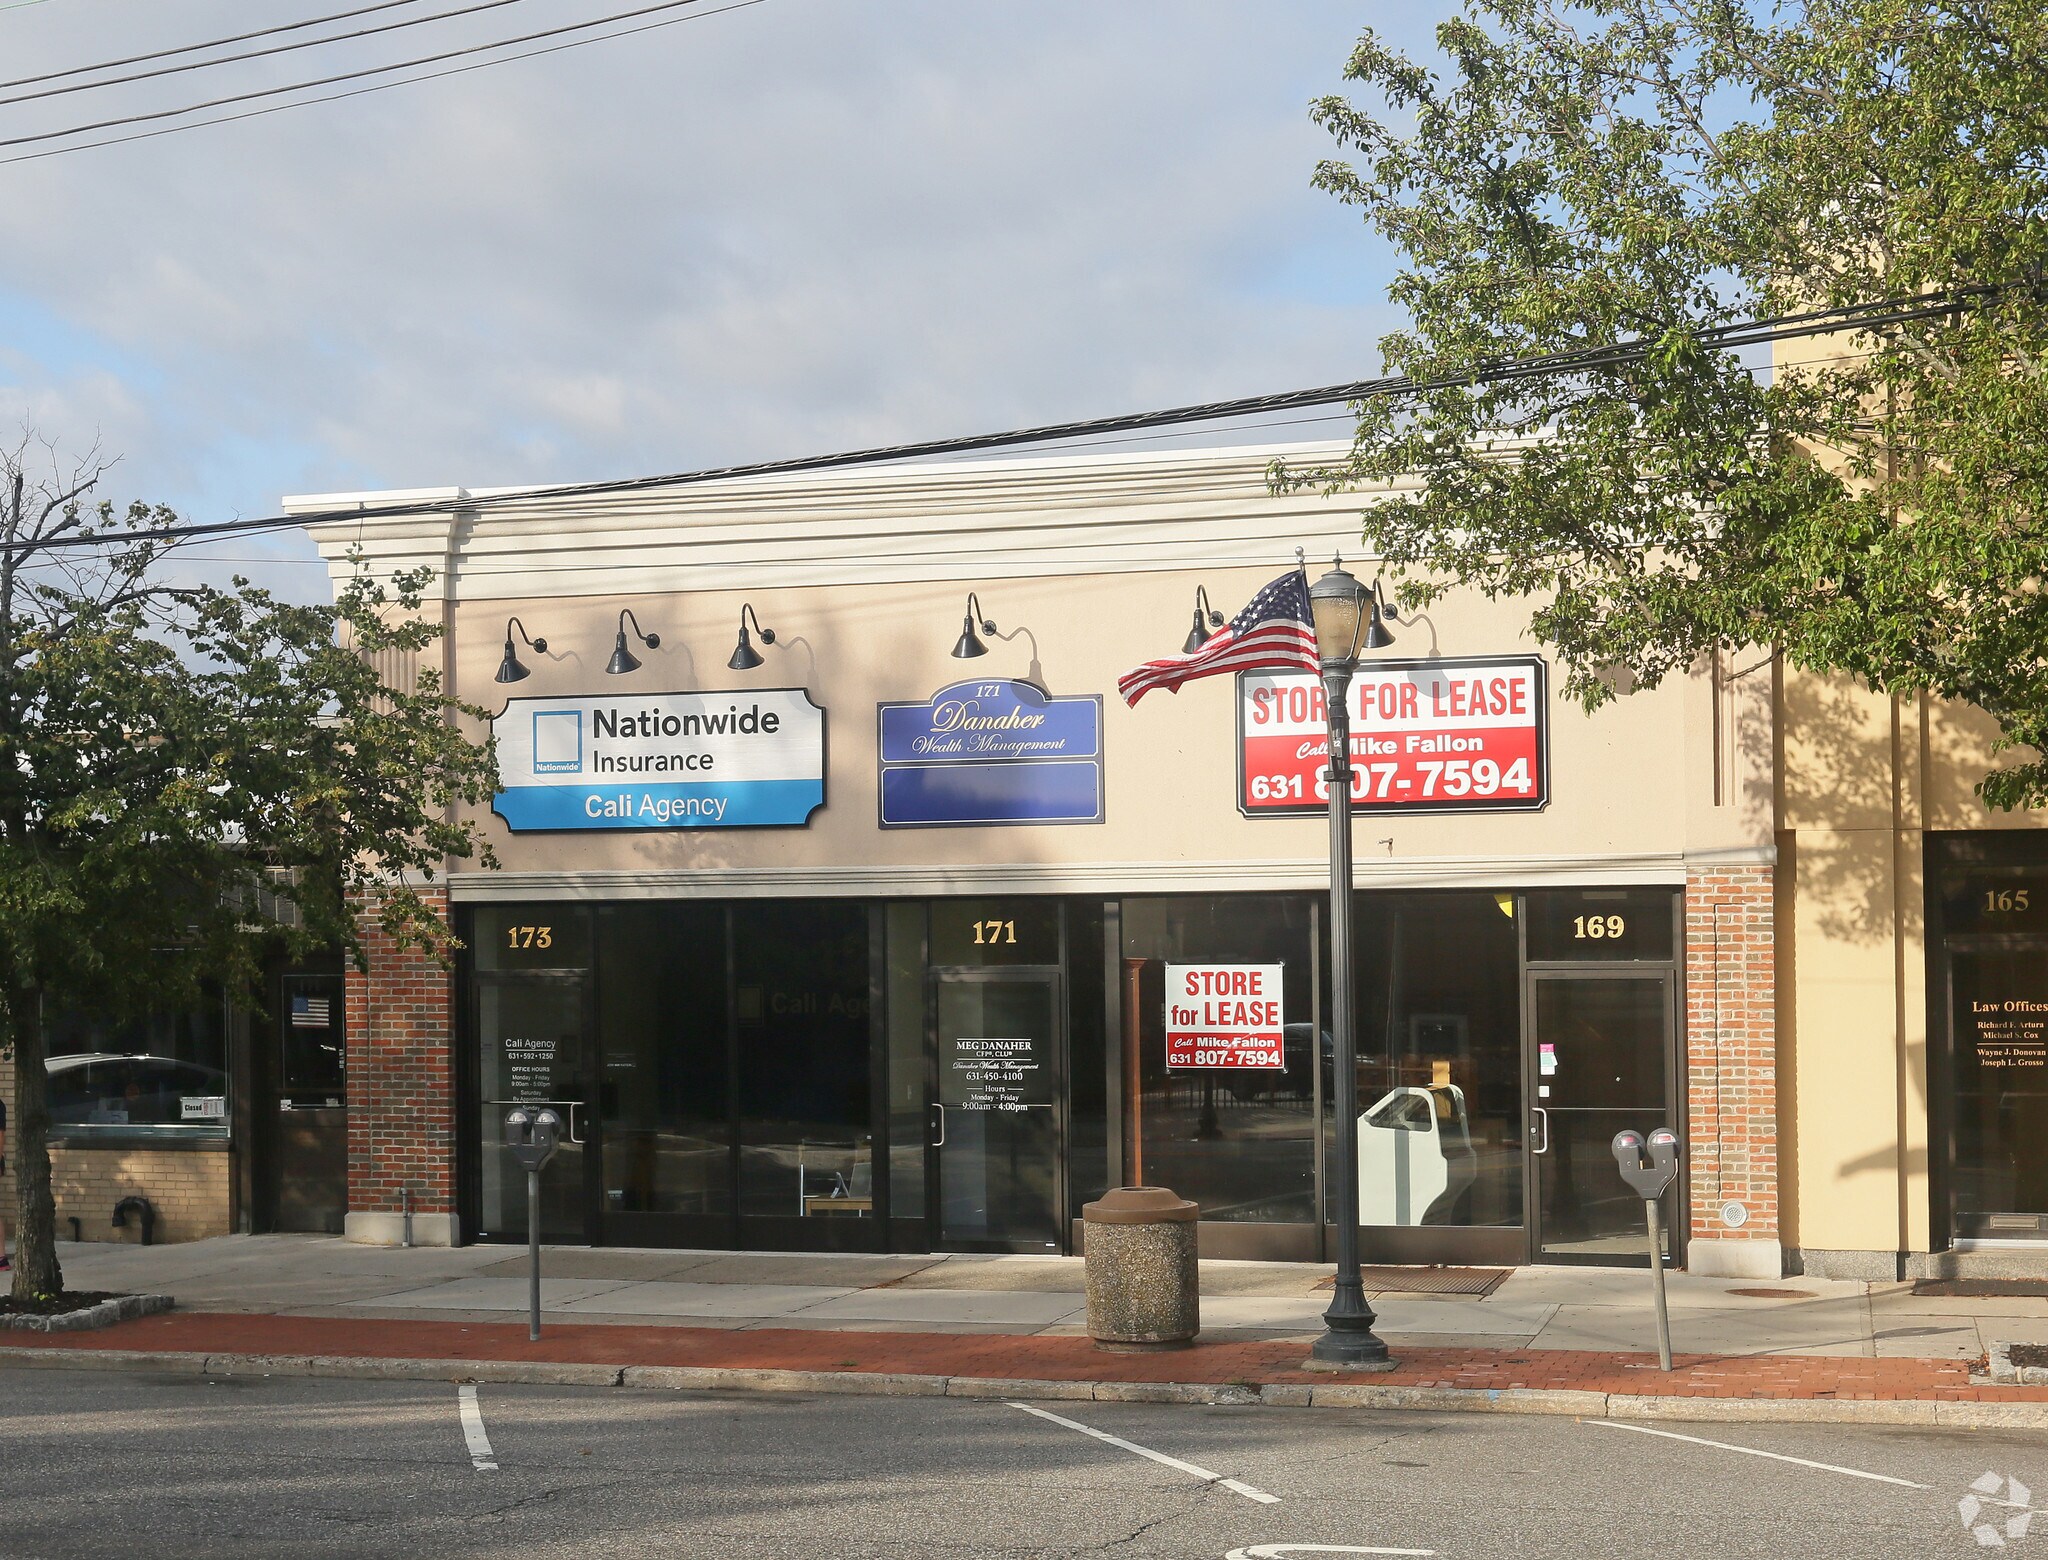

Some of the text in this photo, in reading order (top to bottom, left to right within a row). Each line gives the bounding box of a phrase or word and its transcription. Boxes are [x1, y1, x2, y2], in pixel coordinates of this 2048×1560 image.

[975, 685, 1000, 698] 171
[1253, 677, 1526, 725] STOR FOR LEASE
[593, 705, 780, 738] Nationwide
[930, 700, 1045, 733] Danaher
[911, 733, 1066, 757] Wealth Management
[1296, 741, 1329, 759] Call
[1405, 734, 1483, 754] Fallon
[536, 763, 579, 772] Nationwide
[593, 750, 714, 773] Insurance
[1251, 774, 1303, 800] 631
[585, 793, 728, 822] Cali Agency
[1985, 889, 2029, 912] 165
[972, 920, 1017, 944] 171
[1574, 915, 1625, 938] 169
[508, 926, 552, 949] 173
[1185, 971, 1262, 996] STORE
[1171, 1001, 1279, 1026] for LEASE
[1972, 1001, 2048, 1012] Law Offices
[1977, 1021, 2008, 1029] Richard
[1174, 1037, 1276, 1048] Call Mike Fallon
[1983, 1031, 2013, 1039] Michael
[2023, 1031, 2039, 1039] Cox
[505, 1038, 556, 1049] Cali Agency
[956, 1041, 1032, 1050] MEG DANAHER
[1169, 1050, 1280, 1066] 631 807-7594
[1977, 1048, 2046, 1057] Wayne J. Donovan
[952, 1061, 979, 1070] Danaher
[1000, 1061, 1039, 1072] Management
[1981, 1059, 2006, 1067] Joseph
[966, 1071, 1023, 1081] 631-450-4100
[970, 1094, 994, 1102] Monday
[1000, 1094, 1019, 1102] Friday
[962, 1102, 991, 1110] 9:00am
[998, 1102, 1028, 1113] 4:00pm
